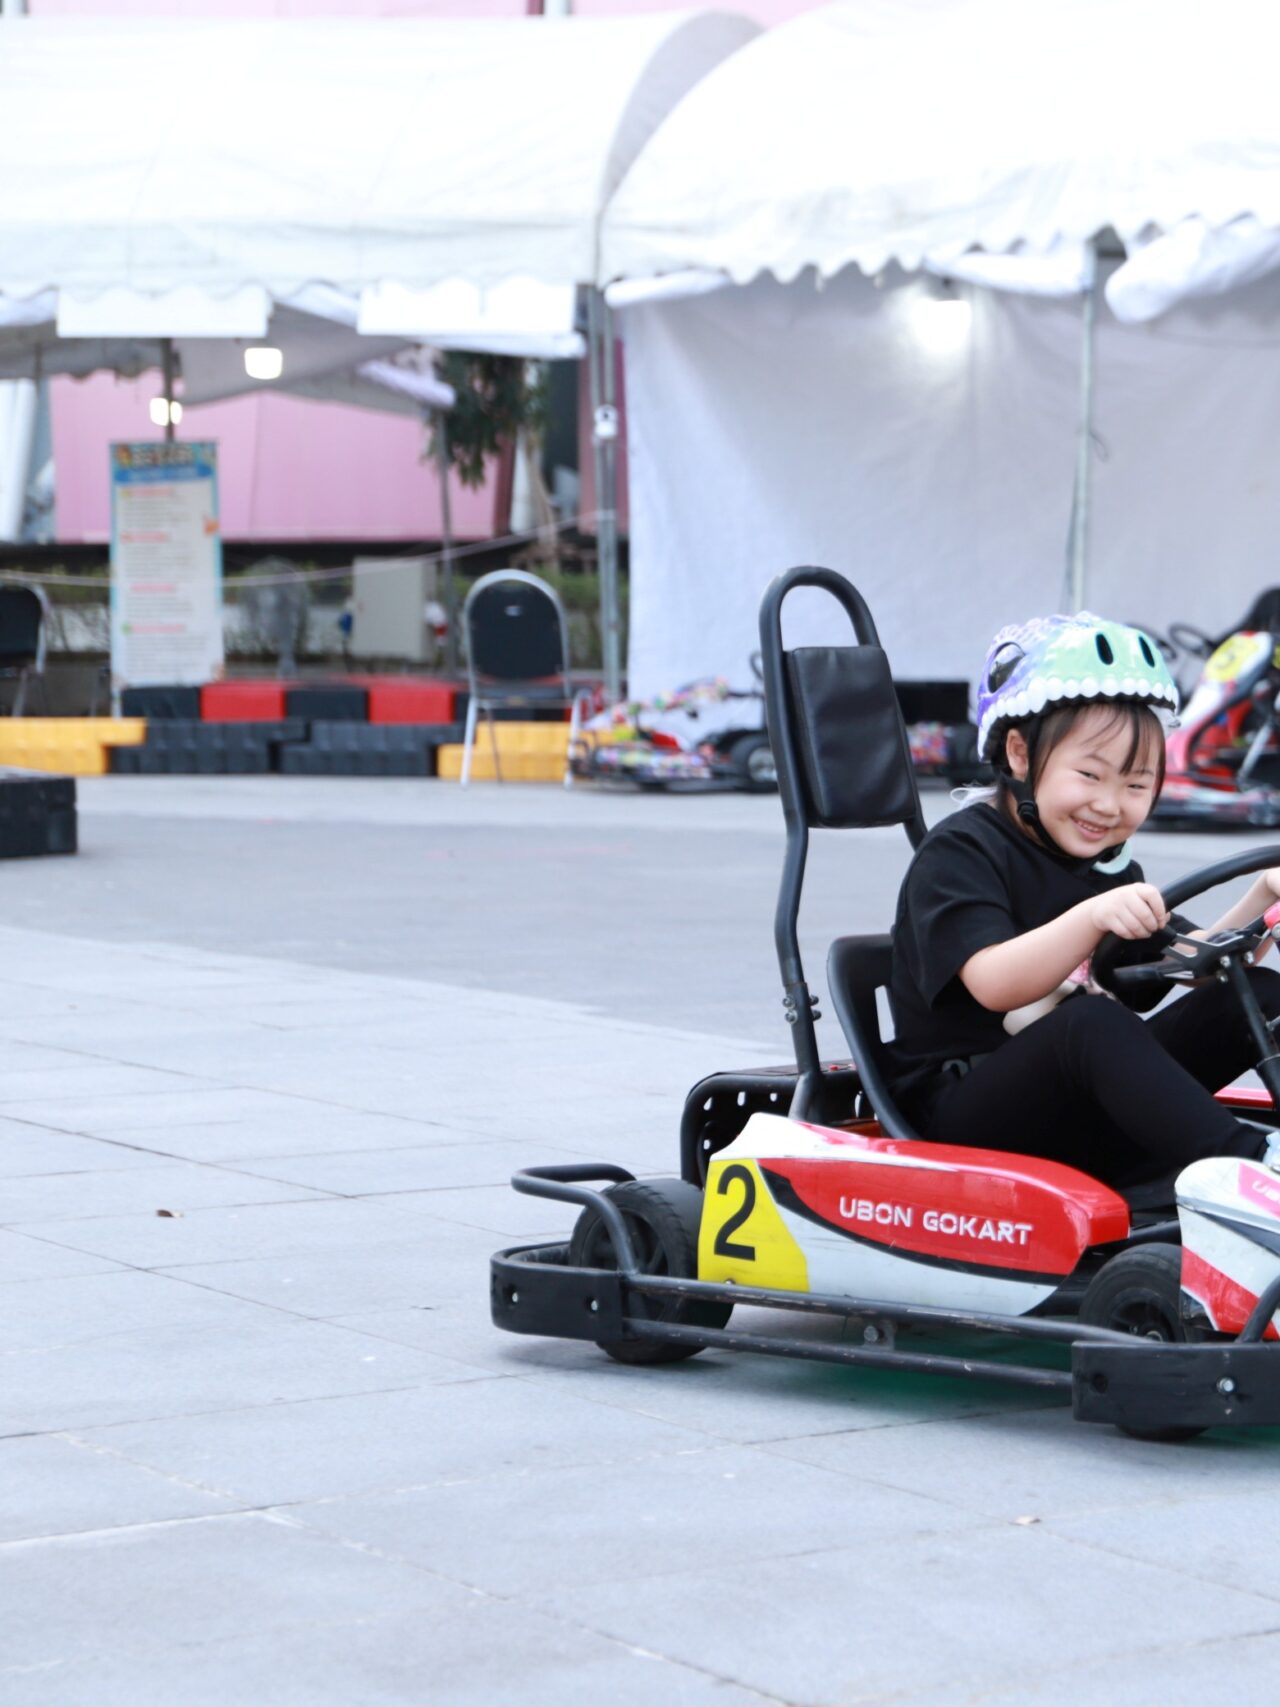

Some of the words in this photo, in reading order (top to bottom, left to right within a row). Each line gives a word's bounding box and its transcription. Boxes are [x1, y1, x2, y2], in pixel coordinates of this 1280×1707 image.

[713, 1164, 756, 1261] 2
[839, 1196, 913, 1228] UBON
[923, 1210, 1033, 1245] GOKART
